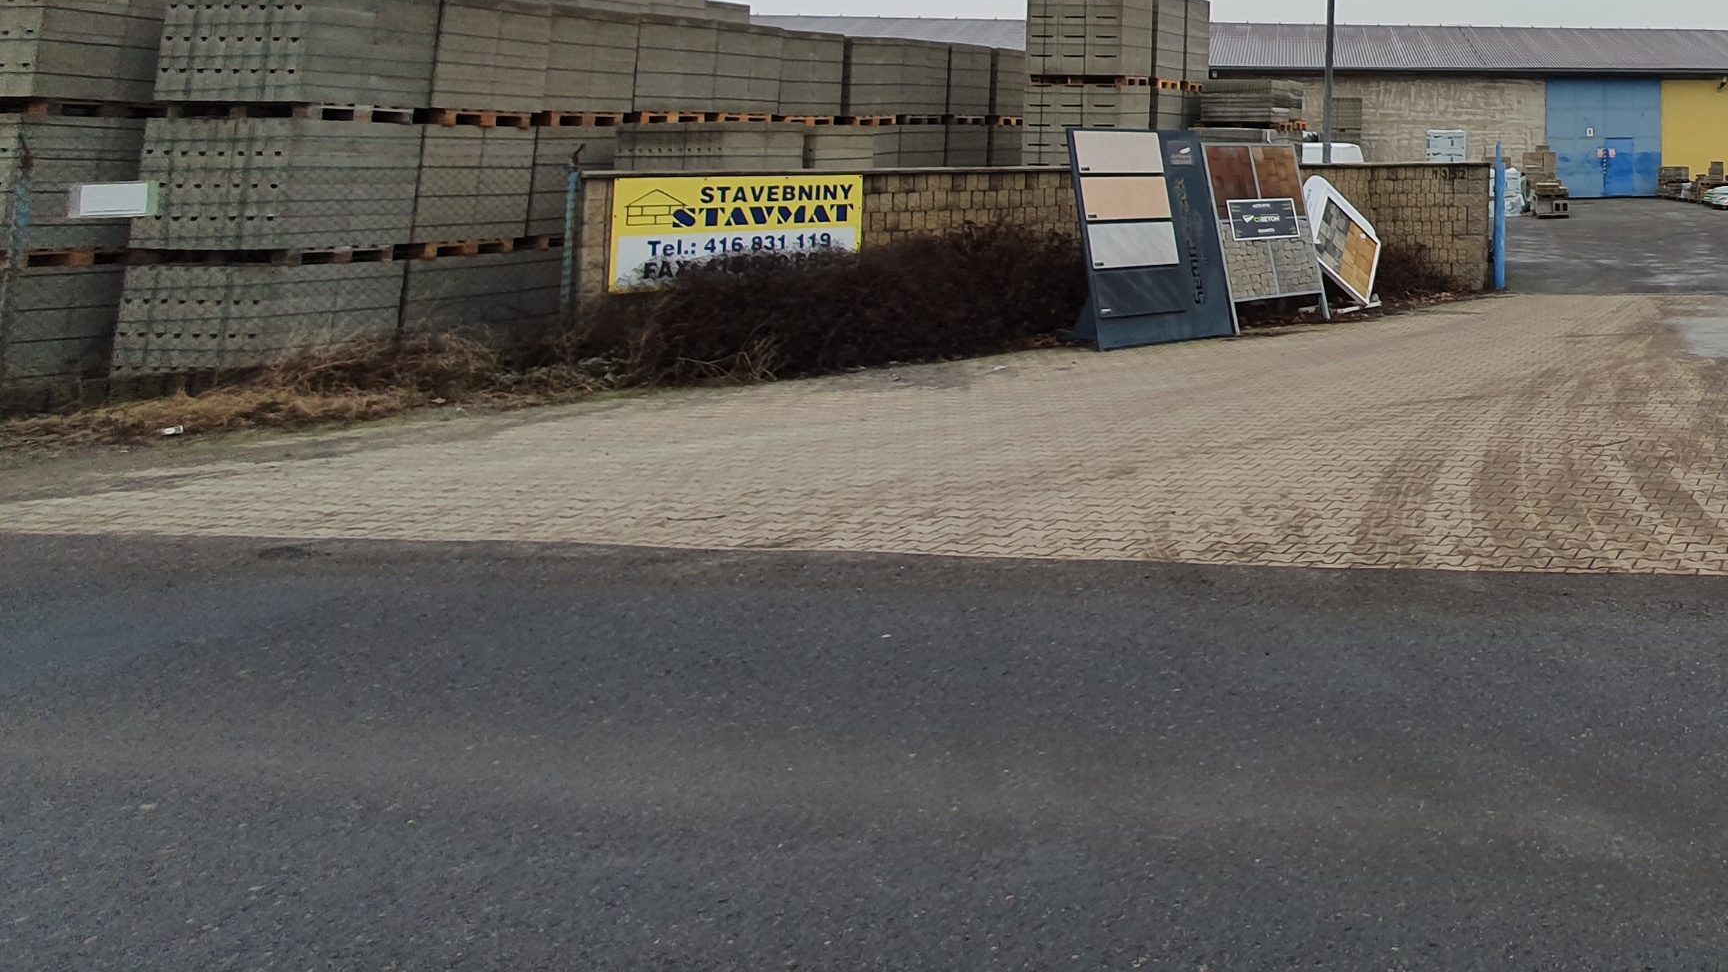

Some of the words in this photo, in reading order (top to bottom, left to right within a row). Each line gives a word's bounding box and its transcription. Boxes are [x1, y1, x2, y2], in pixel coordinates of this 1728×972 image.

[700, 184, 853, 204] STAVEBNINY
[672, 203, 854, 228] STAVMAT
[647, 239, 697, 257] Tel.:
[704, 236, 744, 253] 416
[751, 234, 786, 251] 831
[797, 232, 832, 248] 119
